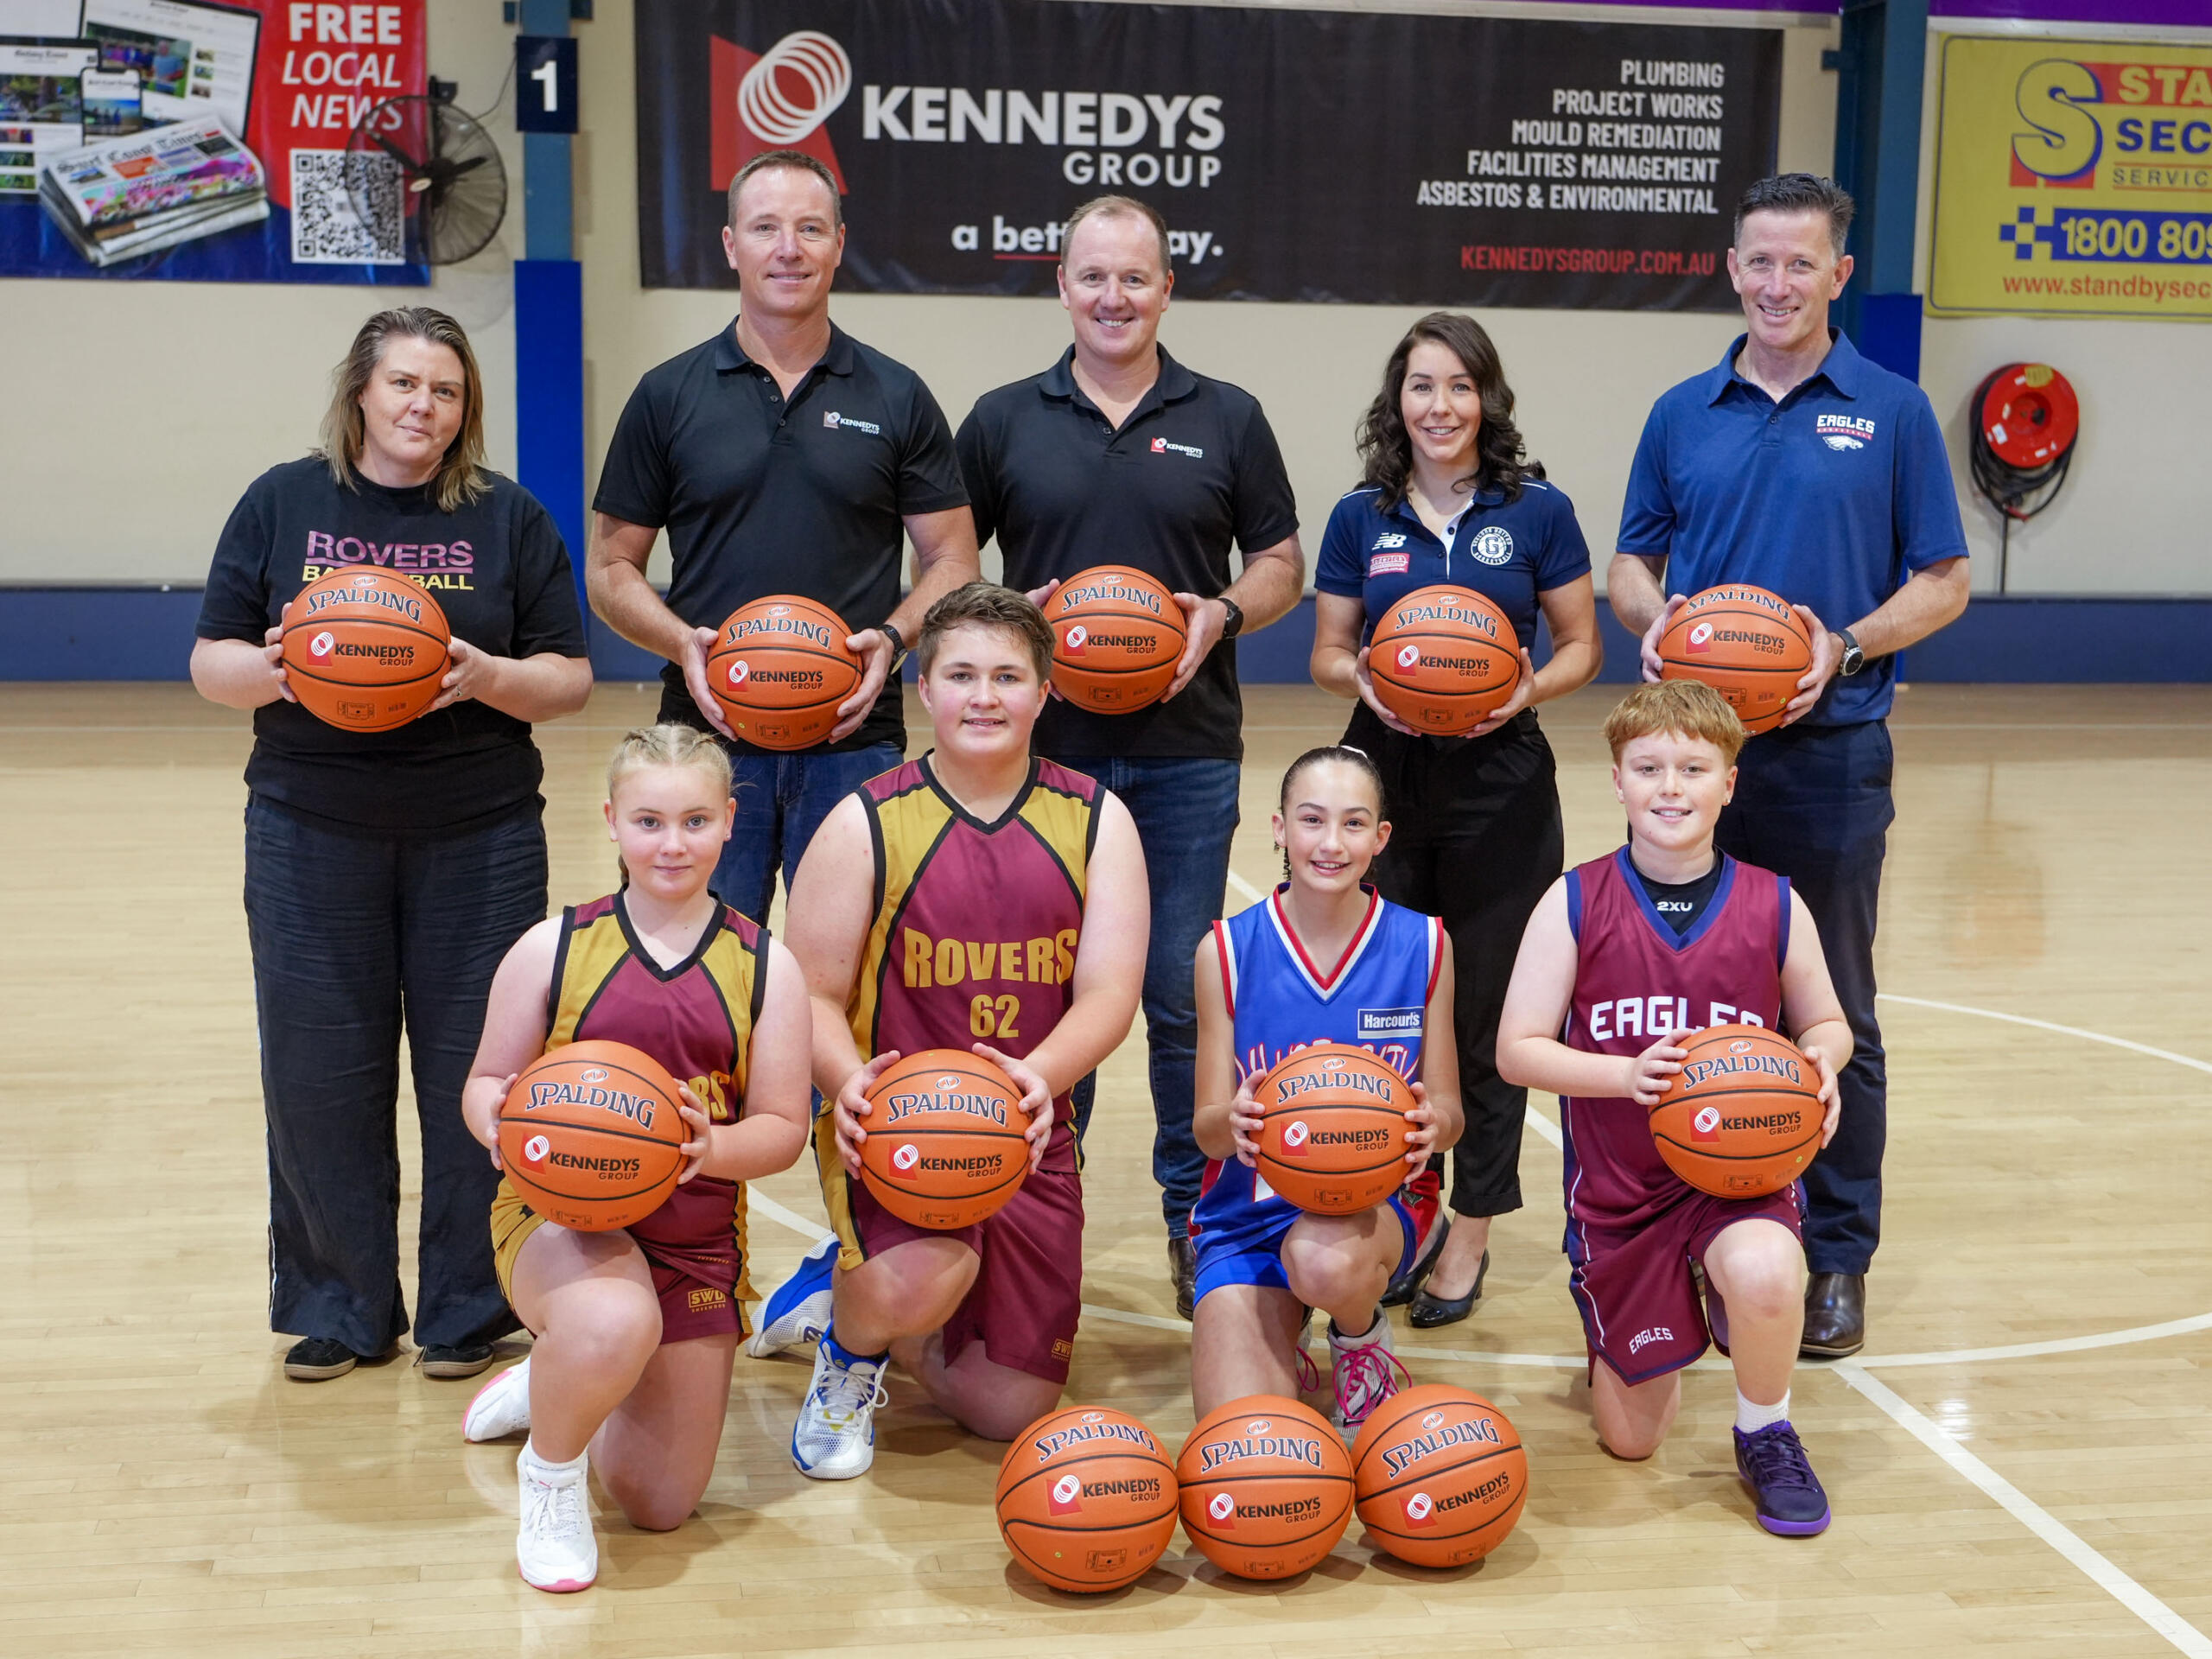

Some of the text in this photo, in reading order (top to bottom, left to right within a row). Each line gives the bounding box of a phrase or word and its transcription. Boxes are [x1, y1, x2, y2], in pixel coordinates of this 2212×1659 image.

[289, 3, 402, 44] FREE
[282, 50, 402, 87] LOCAL
[1621, 60, 1725, 88] PLUMBING
[531, 60, 558, 112] 1
[290, 93, 403, 130] NEWS
[863, 85, 1225, 152] KENNEDYS
[1554, 89, 1724, 120] PROJECT WORKS
[1511, 120, 1721, 151] MOULD REMEDIATION
[1063, 150, 1223, 188] GROUP
[1467, 149, 1719, 183] FACILITIES MANAGEMENT
[1417, 181, 1719, 214] ASBESTOS & ENVIRONMENTAL
[951, 225, 979, 251] a
[1167, 230, 1223, 264] ay.
[2061, 217, 2148, 258] 1800
[1461, 245, 1715, 276] KENNEDYSGROUP.COM.AU
[840, 418, 880, 431] KENNEDYS
[1816, 415, 1876, 435] EAGLES
[307, 530, 474, 568] ROVERS
[306, 588, 421, 624] SPALDING
[1062, 586, 1162, 616] SPALDING
[1686, 590, 1790, 622] SPALDING
[725, 618, 831, 650] SPALDING
[1395, 607, 1497, 640] SPALDING
[334, 643, 415, 658] KENNEDYS
[1087, 634, 1157, 648] KENNEDYS
[1126, 646, 1157, 655] GROUP
[1713, 629, 1786, 649] KENNEDYS
[1753, 644, 1784, 657] GROUP
[379, 658, 414, 666] GROUP
[749, 671, 823, 683] KENNEDYS
[1419, 655, 1491, 671] KENNEDYS
[1459, 669, 1490, 677] GROUP
[1657, 901, 1694, 912] 2XU
[904, 926, 1078, 988] ROVERS
[969, 994, 1020, 1039] 62
[1277, 1072, 1392, 1104] SPALDING
[1681, 1056, 1801, 1090] SPALDING
[525, 1083, 656, 1131] SPALDING
[887, 1093, 1007, 1128] SPALDING
[1721, 1110, 1802, 1131] KENNEDYS
[1310, 1128, 1389, 1145] KENNEDYS
[1769, 1123, 1802, 1136] GROUP
[549, 1151, 640, 1172] KENNEDYS
[1355, 1141, 1389, 1152] GROUP
[598, 1170, 639, 1181] GROUP
[919, 1154, 1003, 1171] KENNEDYS
[967, 1166, 1002, 1179] GROUP
[691, 1289, 725, 1305] SWD
[1629, 1327, 1675, 1355] EAGLES
[1035, 1423, 1156, 1464] SPALDING
[1200, 1437, 1323, 1473] SPALDING
[1381, 1417, 1501, 1479] SPALDING
[1082, 1478, 1160, 1498] KENNEDYS
[1130, 1491, 1160, 1503] GROUP
[1434, 1471, 1510, 1514] KENNEDYS
[1482, 1483, 1511, 1507] GROUP
[1236, 1496, 1321, 1519] KENNEDYS
[1285, 1510, 1321, 1524] GROUP
